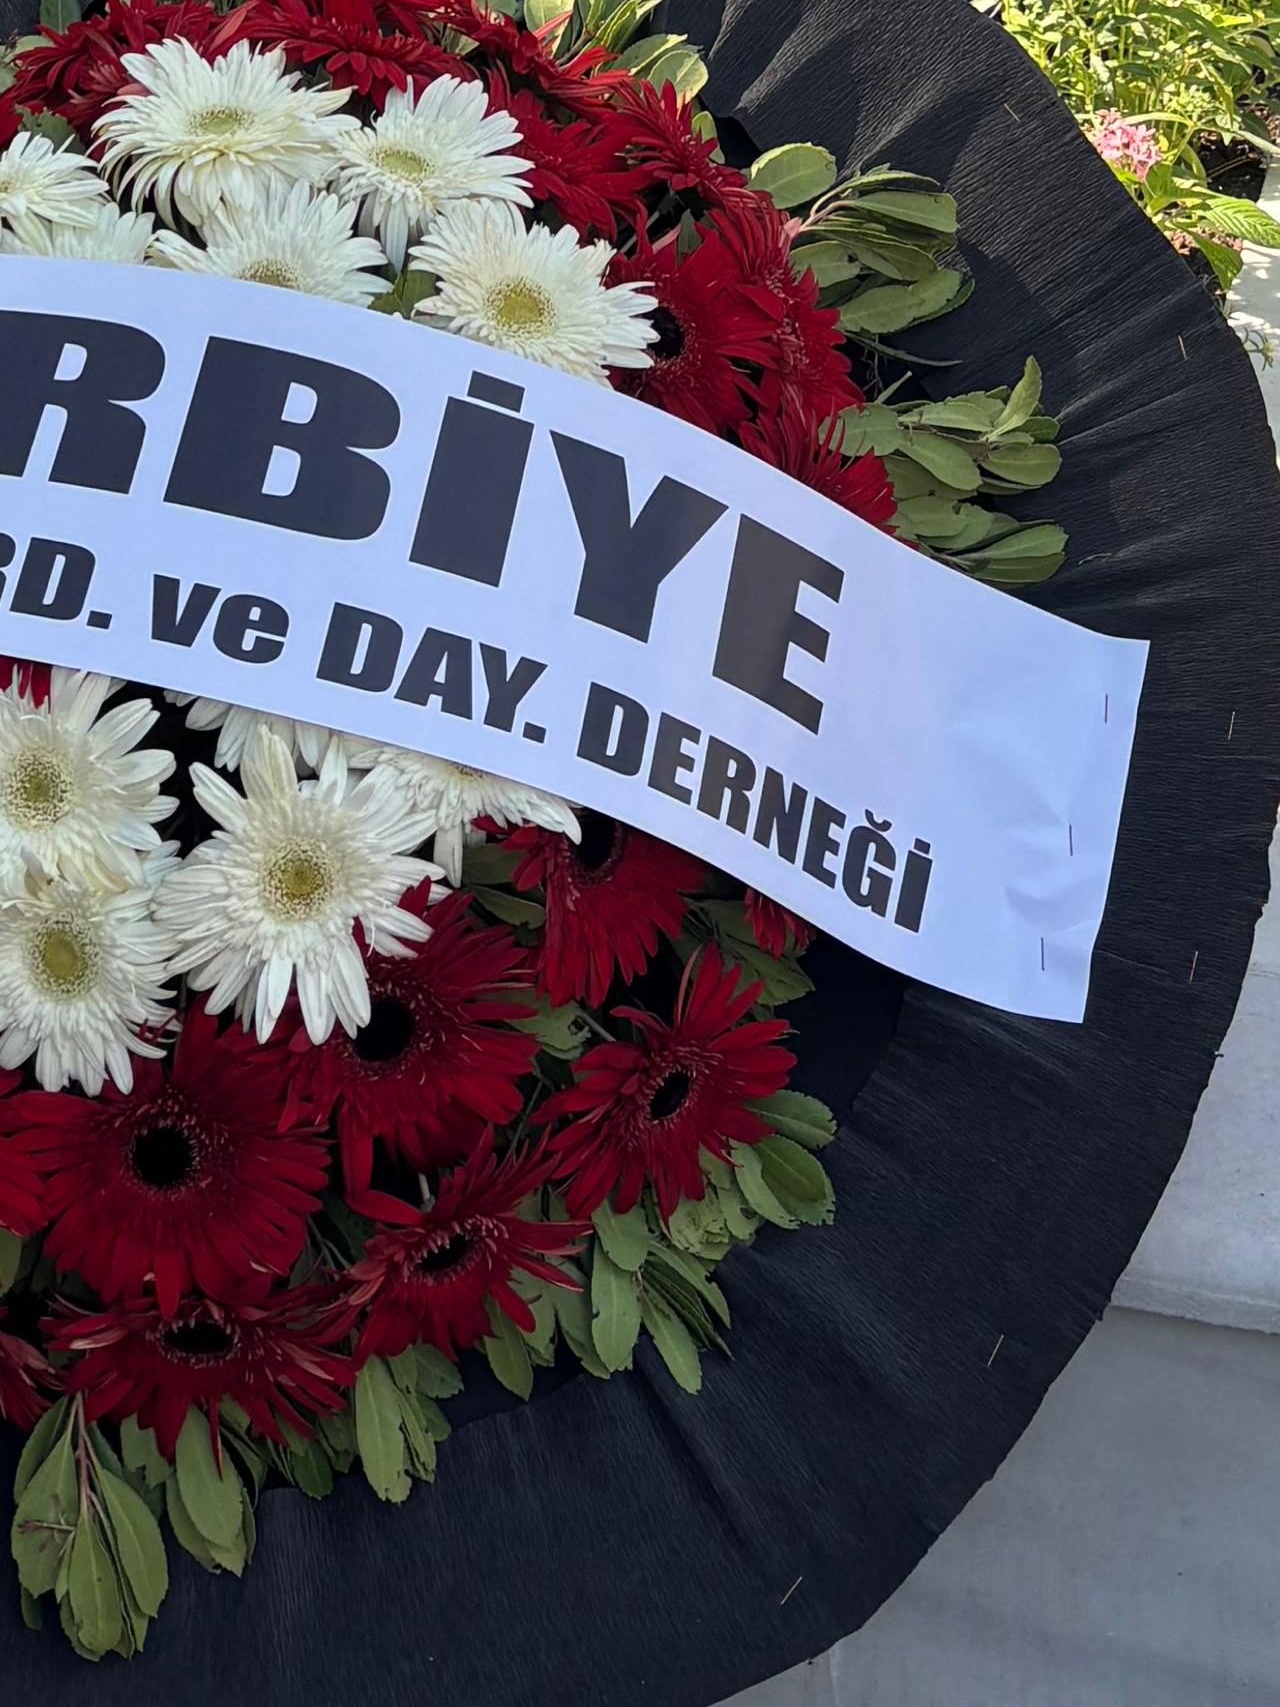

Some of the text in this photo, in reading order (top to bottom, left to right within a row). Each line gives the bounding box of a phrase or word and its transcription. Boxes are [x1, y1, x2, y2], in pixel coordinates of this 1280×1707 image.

[151, 573, 291, 664] ve
[315, 601, 548, 744] DAY.
[575, 681, 934, 934] DERNEĞİ
